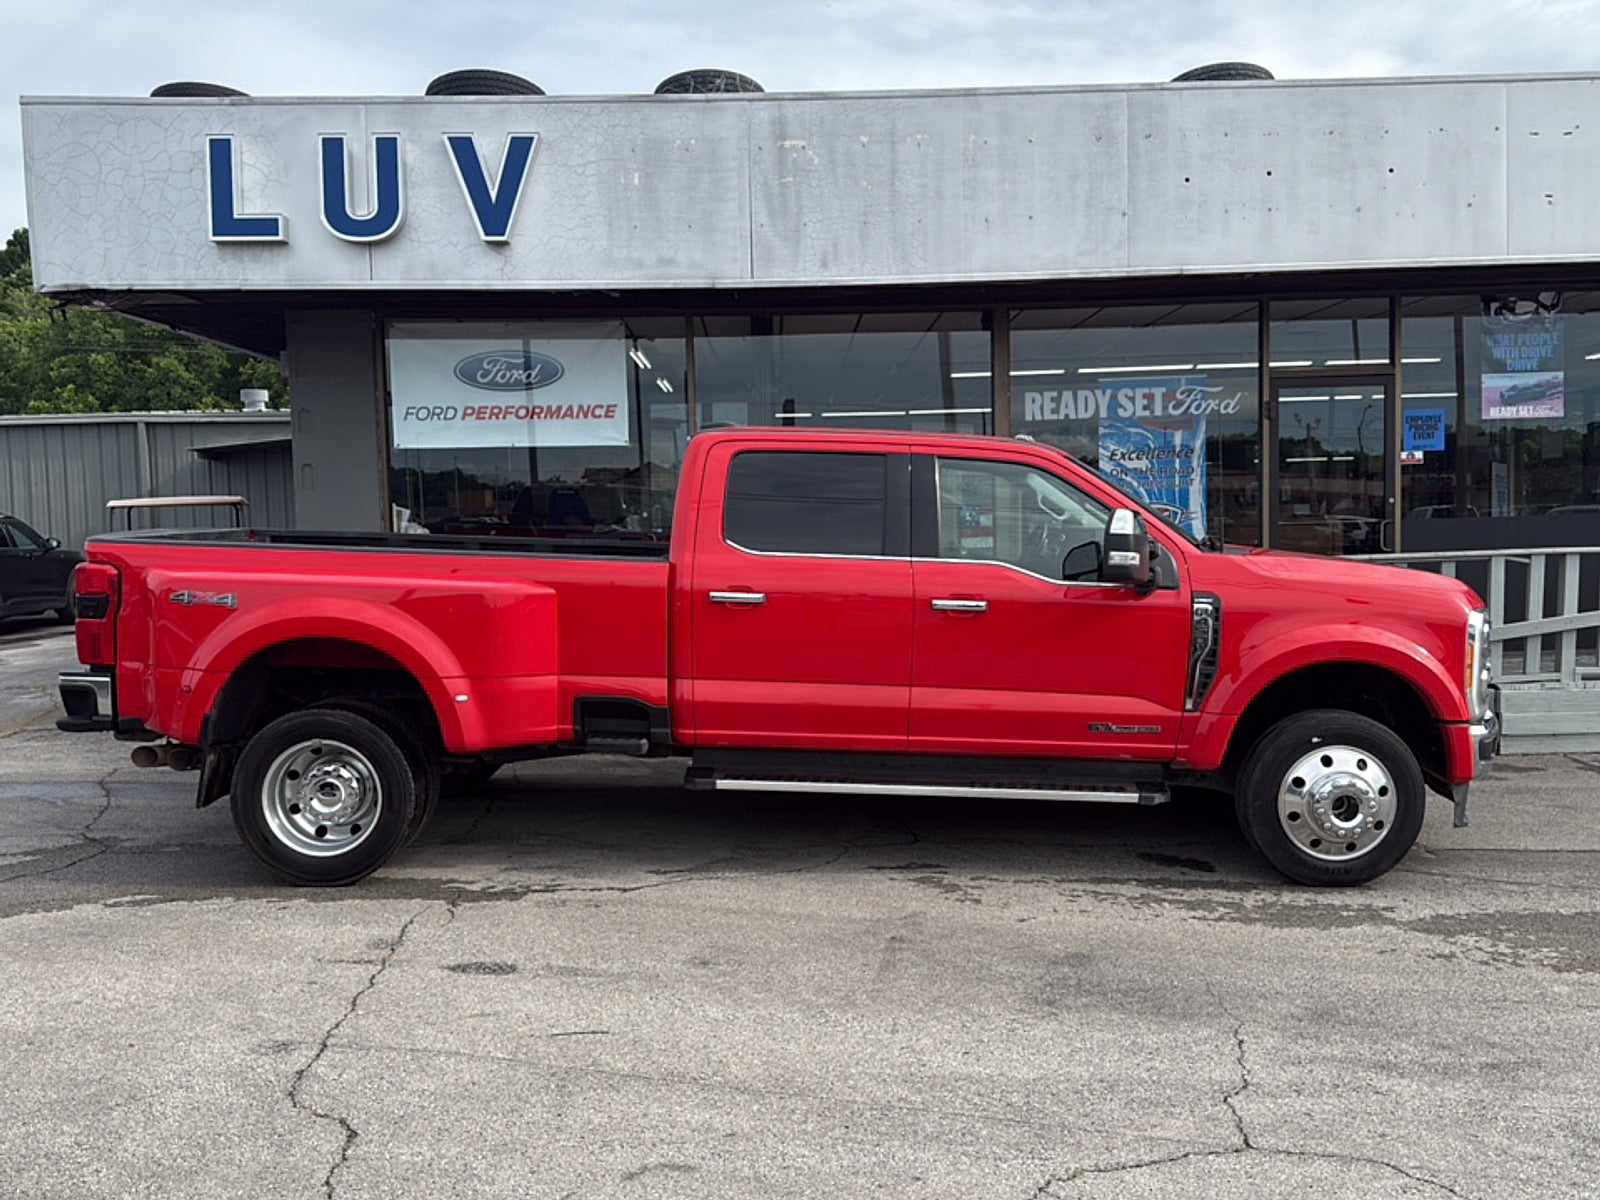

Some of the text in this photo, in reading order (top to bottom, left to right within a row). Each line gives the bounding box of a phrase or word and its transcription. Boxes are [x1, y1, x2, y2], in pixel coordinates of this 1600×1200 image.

[1518, 332, 1560, 345] PEOPLE
[1492, 345, 1554, 359] WITH DRIVE
[476, 356, 542, 383] Ford
[1506, 359, 1540, 371] DRIVE
[1025, 385, 1241, 421] READY SET Ford
[403, 404, 618, 421] FORD PERFORMANCE
[1490, 405, 1518, 417] READY
[1413, 431, 1436, 440] EVENT
[1109, 446, 1195, 463] Excellence
[1110, 465, 1195, 478] ON THE ROAD
